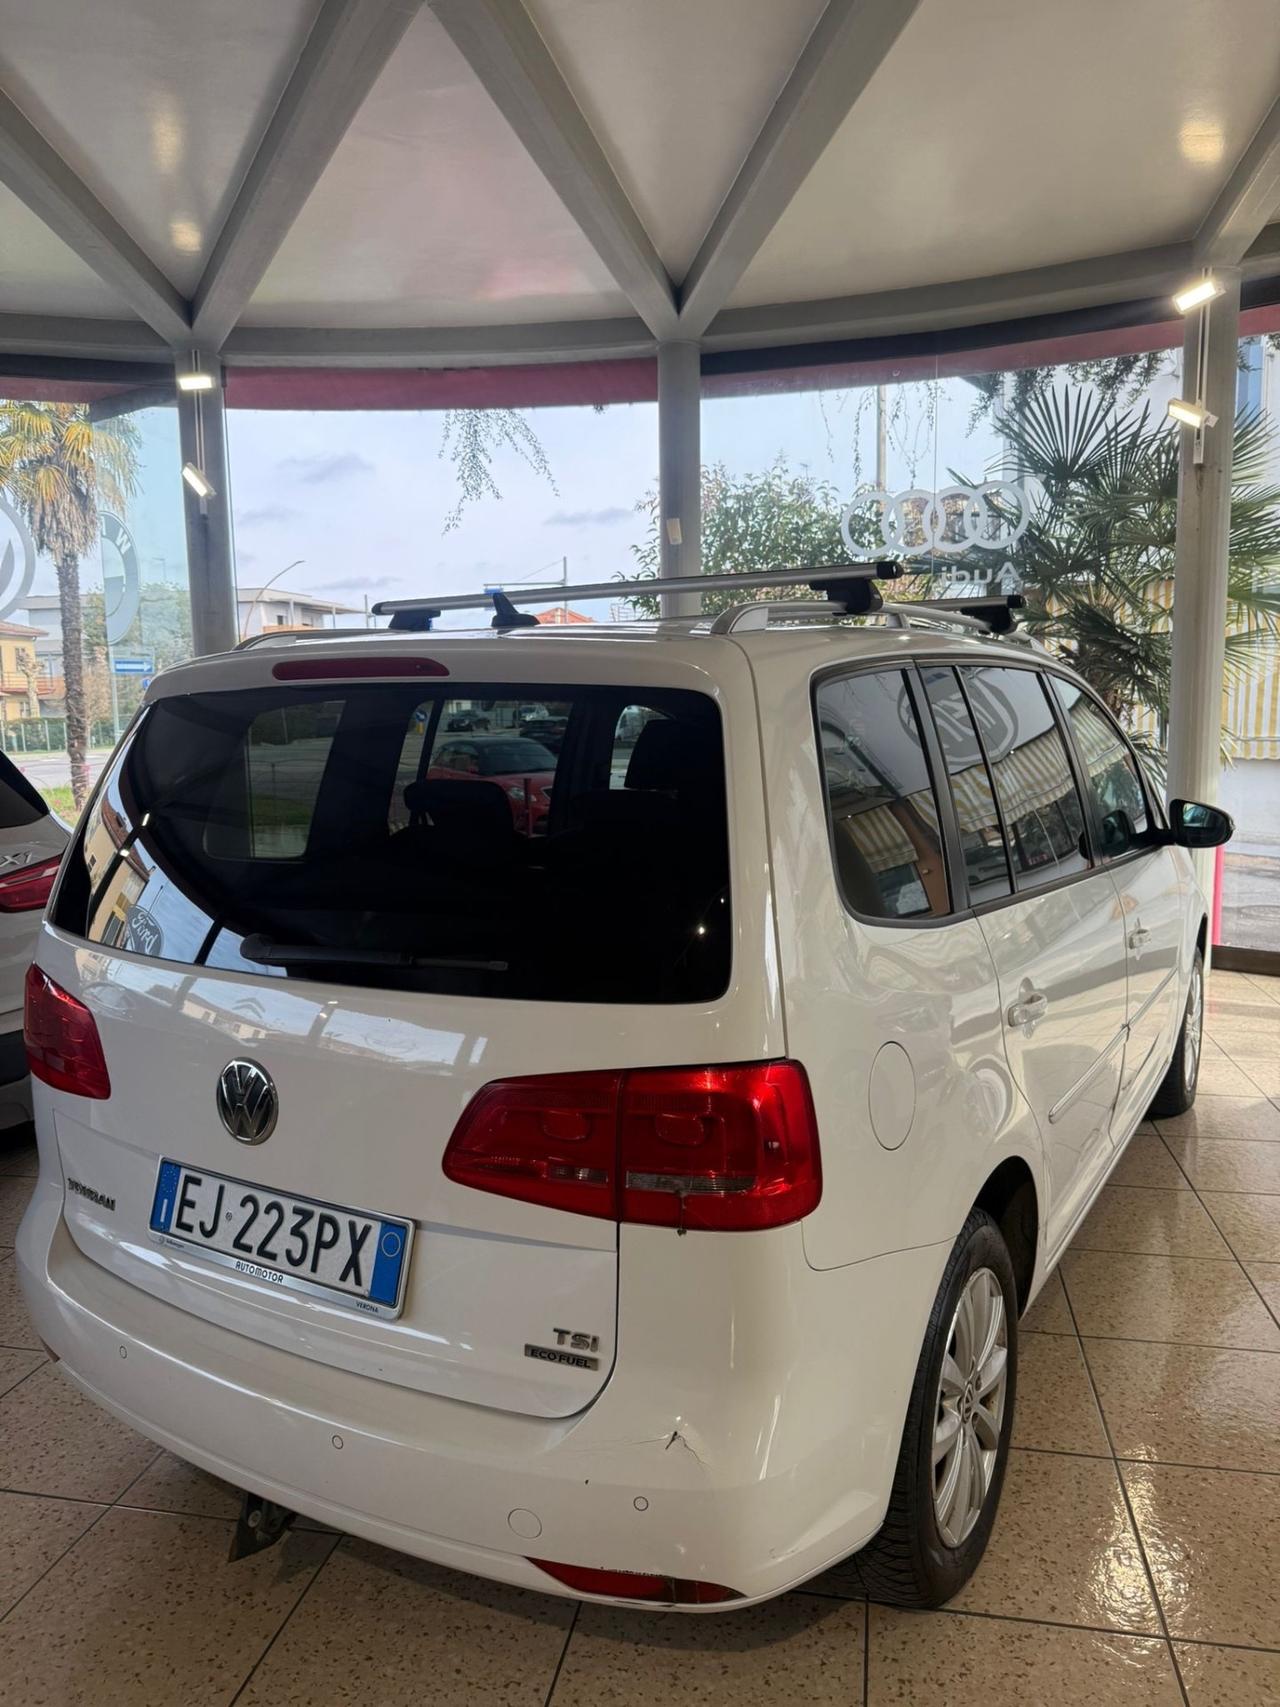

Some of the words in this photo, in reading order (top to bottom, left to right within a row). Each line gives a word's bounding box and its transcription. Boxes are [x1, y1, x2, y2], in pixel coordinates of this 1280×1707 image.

[235, 1260, 284, 1284] AUTOMOTOR
[356, 1301, 379, 1313] VERONA
[553, 1327, 600, 1353] TSI
